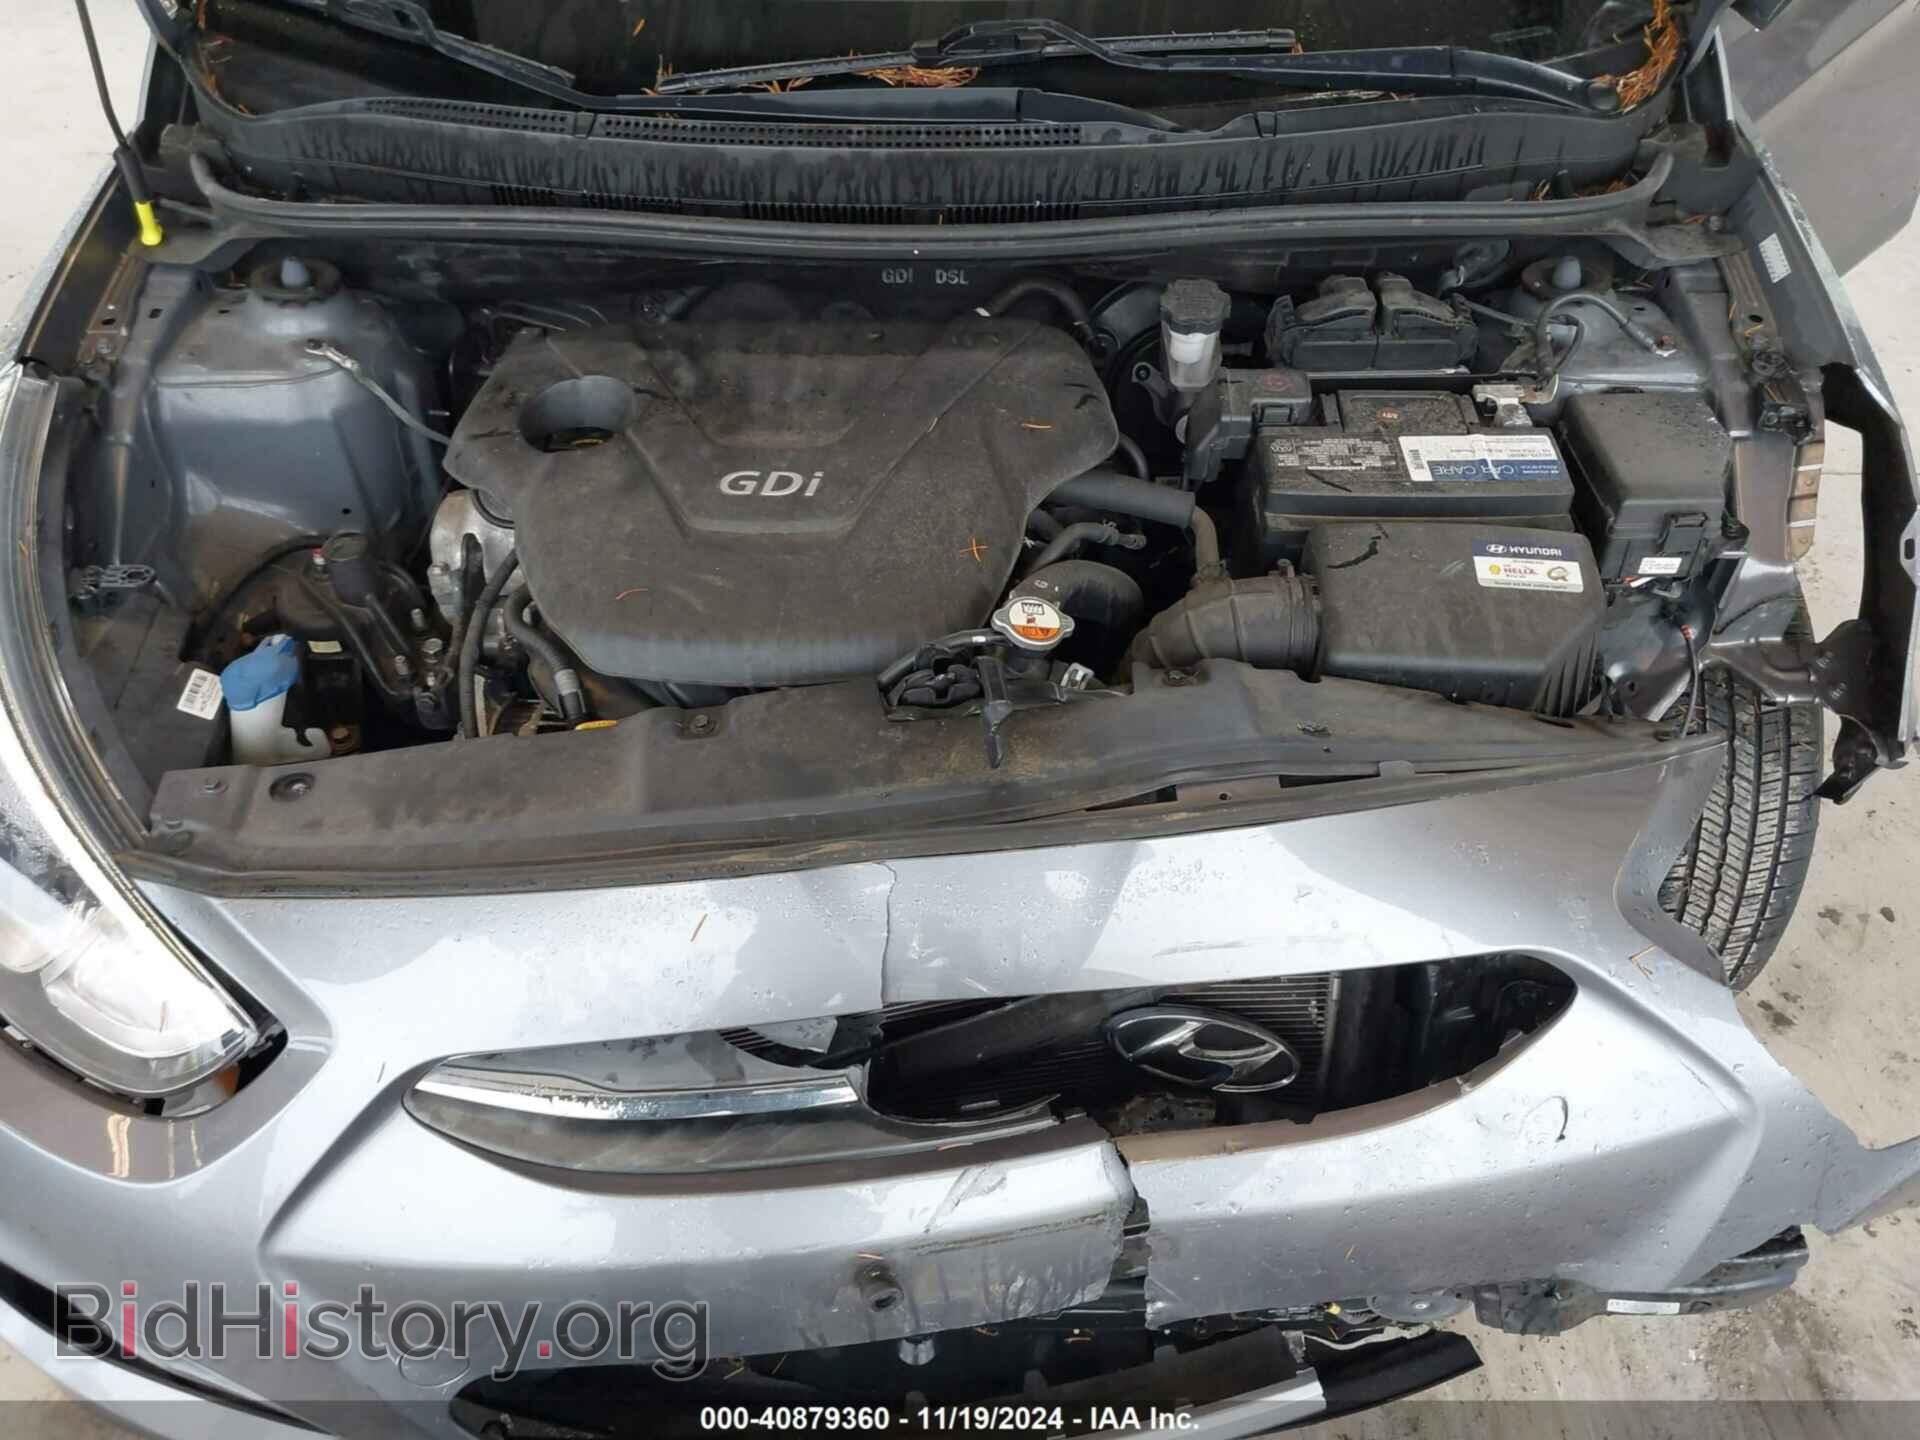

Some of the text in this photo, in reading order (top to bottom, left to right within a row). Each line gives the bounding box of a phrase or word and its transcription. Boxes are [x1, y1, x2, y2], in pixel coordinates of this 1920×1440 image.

[936, 269, 969, 285] DSL
[1432, 464, 1475, 475] CARE
[720, 470, 824, 496] GDi
[1510, 546, 1562, 556] HYUNDAI
